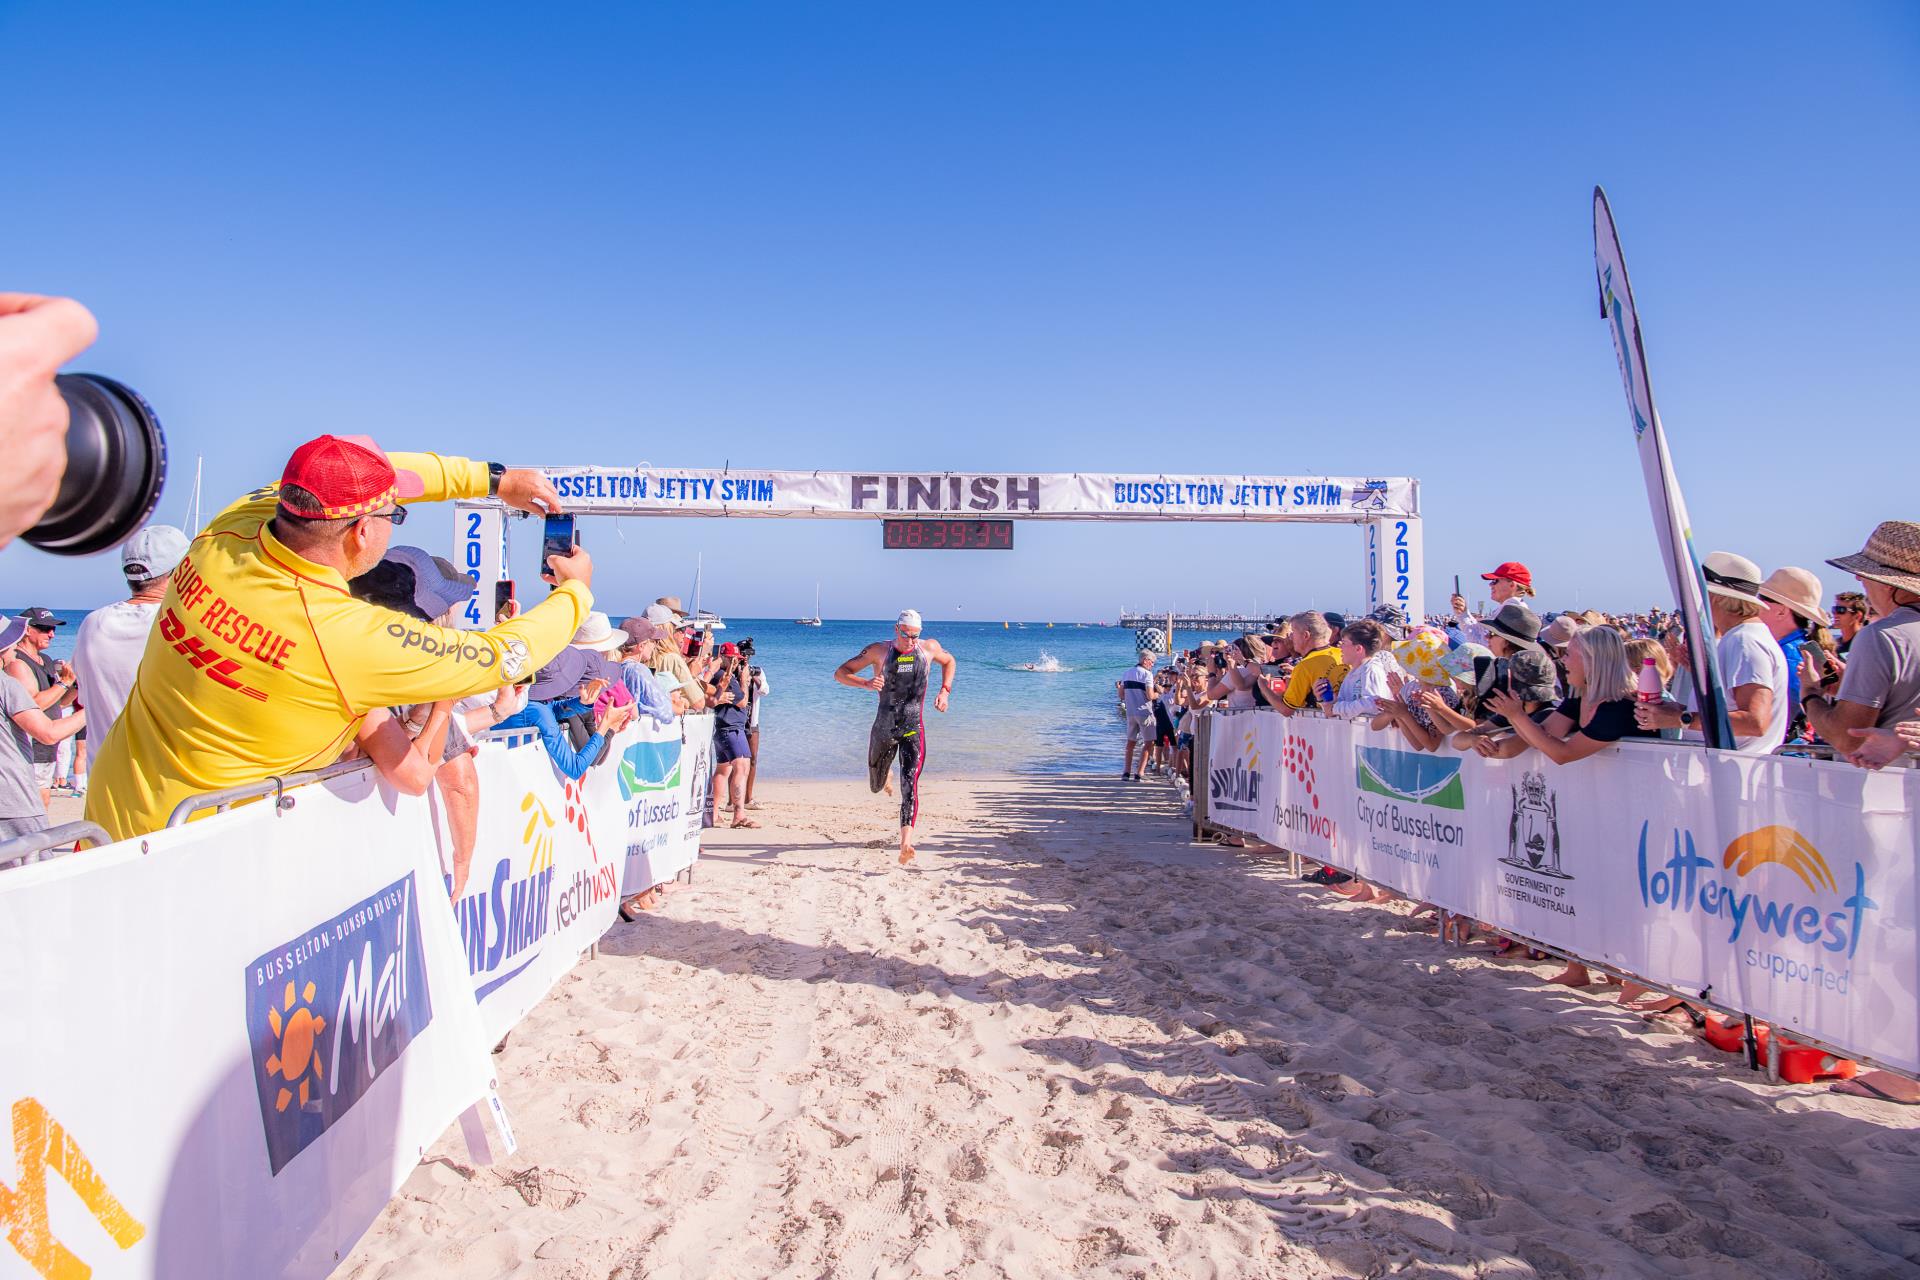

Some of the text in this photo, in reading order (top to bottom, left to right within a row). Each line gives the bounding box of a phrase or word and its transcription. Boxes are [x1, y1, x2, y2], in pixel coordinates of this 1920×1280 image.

[547, 475, 774, 502] SSELTON JETTY SWIM
[851, 475, 1040, 511] FINISH
[1114, 482, 1342, 506] BUSSELTON JETTY SWIM
[887, 521, 1011, 548] 08:39:34
[173, 556, 297, 671] SURF RESCUE
[160, 607, 246, 690] DHL
[386, 623, 496, 668] Colorado
[1272, 797, 1337, 848] healthway
[1357, 796, 1464, 848] City of Busselton
[1372, 836, 1440, 870] Events Capital WA
[1496, 884, 1577, 917] WESTERN AUSTRALIA
[1504, 872, 1566, 898] GOVERNMENT OF
[1637, 819, 1879, 960] lotterywest
[257, 888, 402, 987] BUSSELTON-DUNSBOROUGH
[330, 878, 410, 1096] Mail
[1745, 948, 1849, 996] supported
